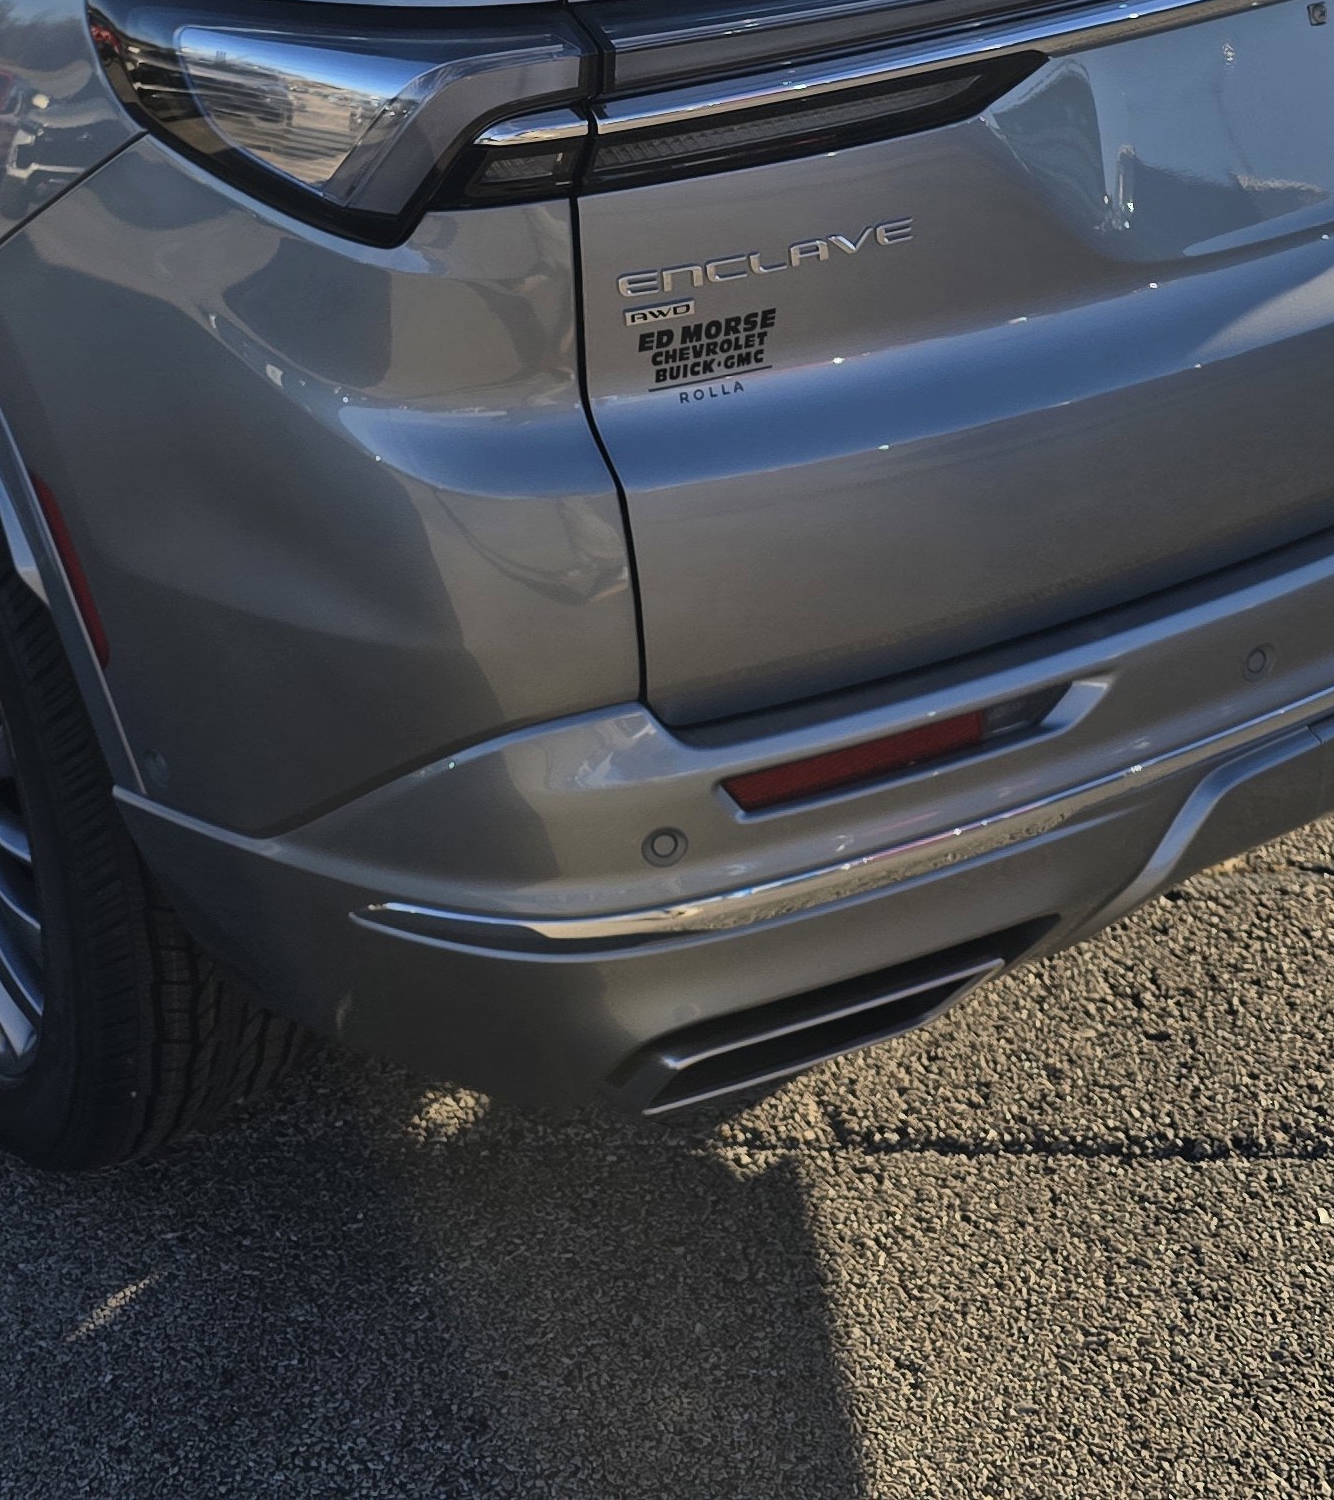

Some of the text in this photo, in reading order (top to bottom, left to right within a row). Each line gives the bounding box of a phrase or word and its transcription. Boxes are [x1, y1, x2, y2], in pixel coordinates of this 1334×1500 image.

[619, 216, 914, 297] ENCLAVE
[629, 302, 692, 323] AWD
[638, 308, 776, 352] ED MORSE
[650, 331, 768, 367] CHEVROLET
[679, 381, 745, 404] ROLLA
